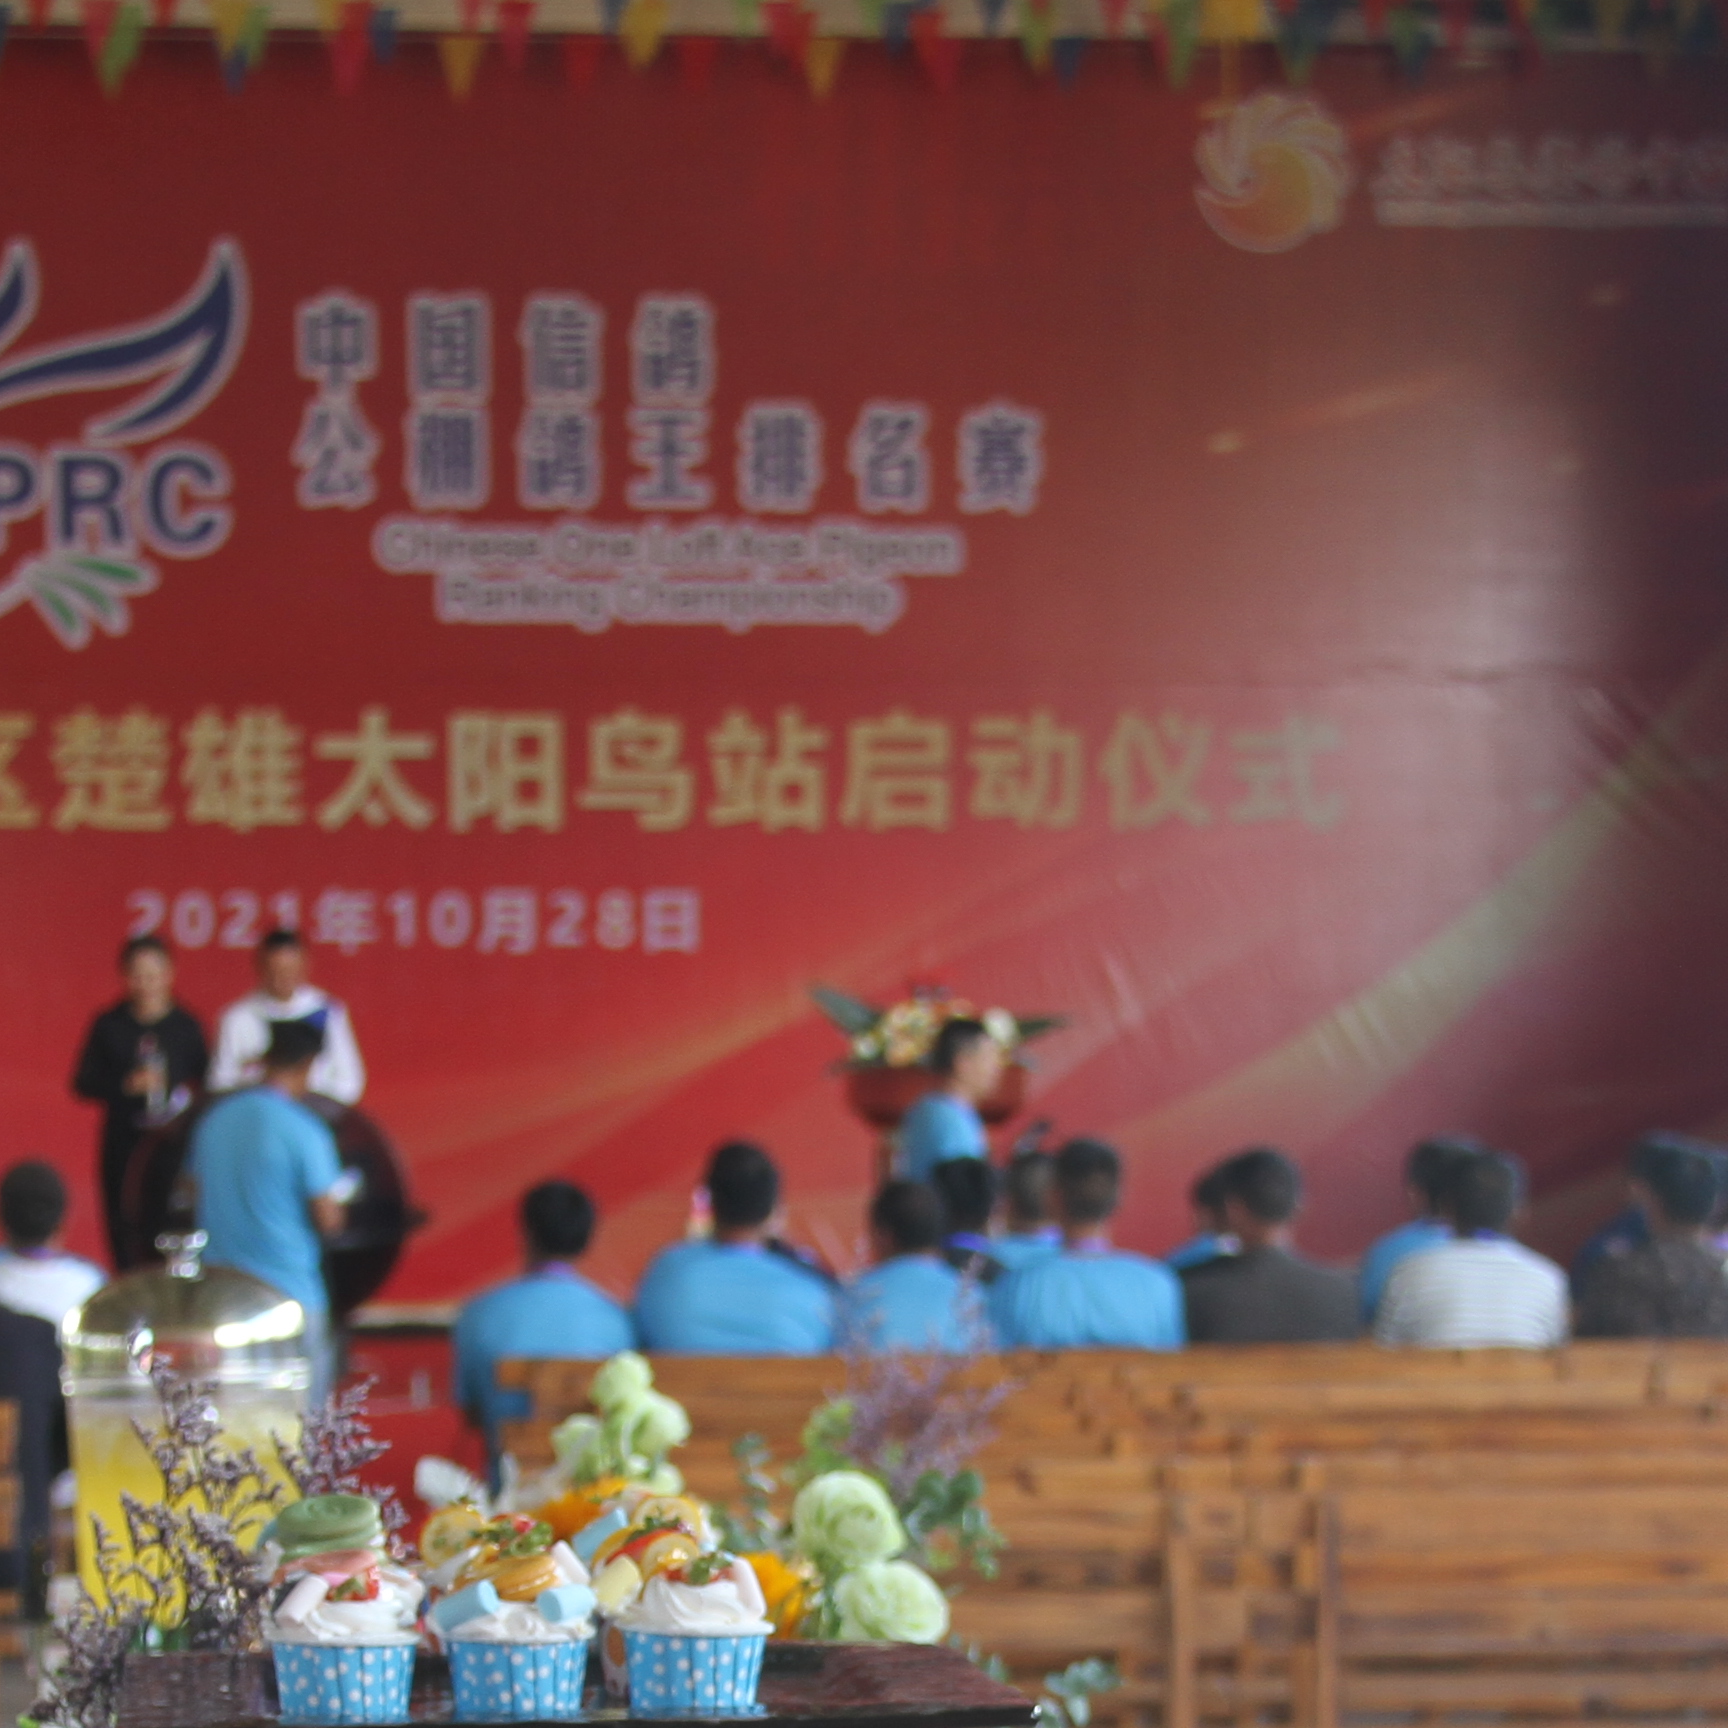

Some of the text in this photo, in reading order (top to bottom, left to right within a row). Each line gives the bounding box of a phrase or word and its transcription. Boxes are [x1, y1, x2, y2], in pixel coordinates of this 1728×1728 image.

[298, 294, 710, 398] 中国信鸽
[296, 401, 1042, 511] 公棚鸽王排名赛
[554, 521, 636, 565] One
[127, 886, 702, 954] 2021年10月28日
